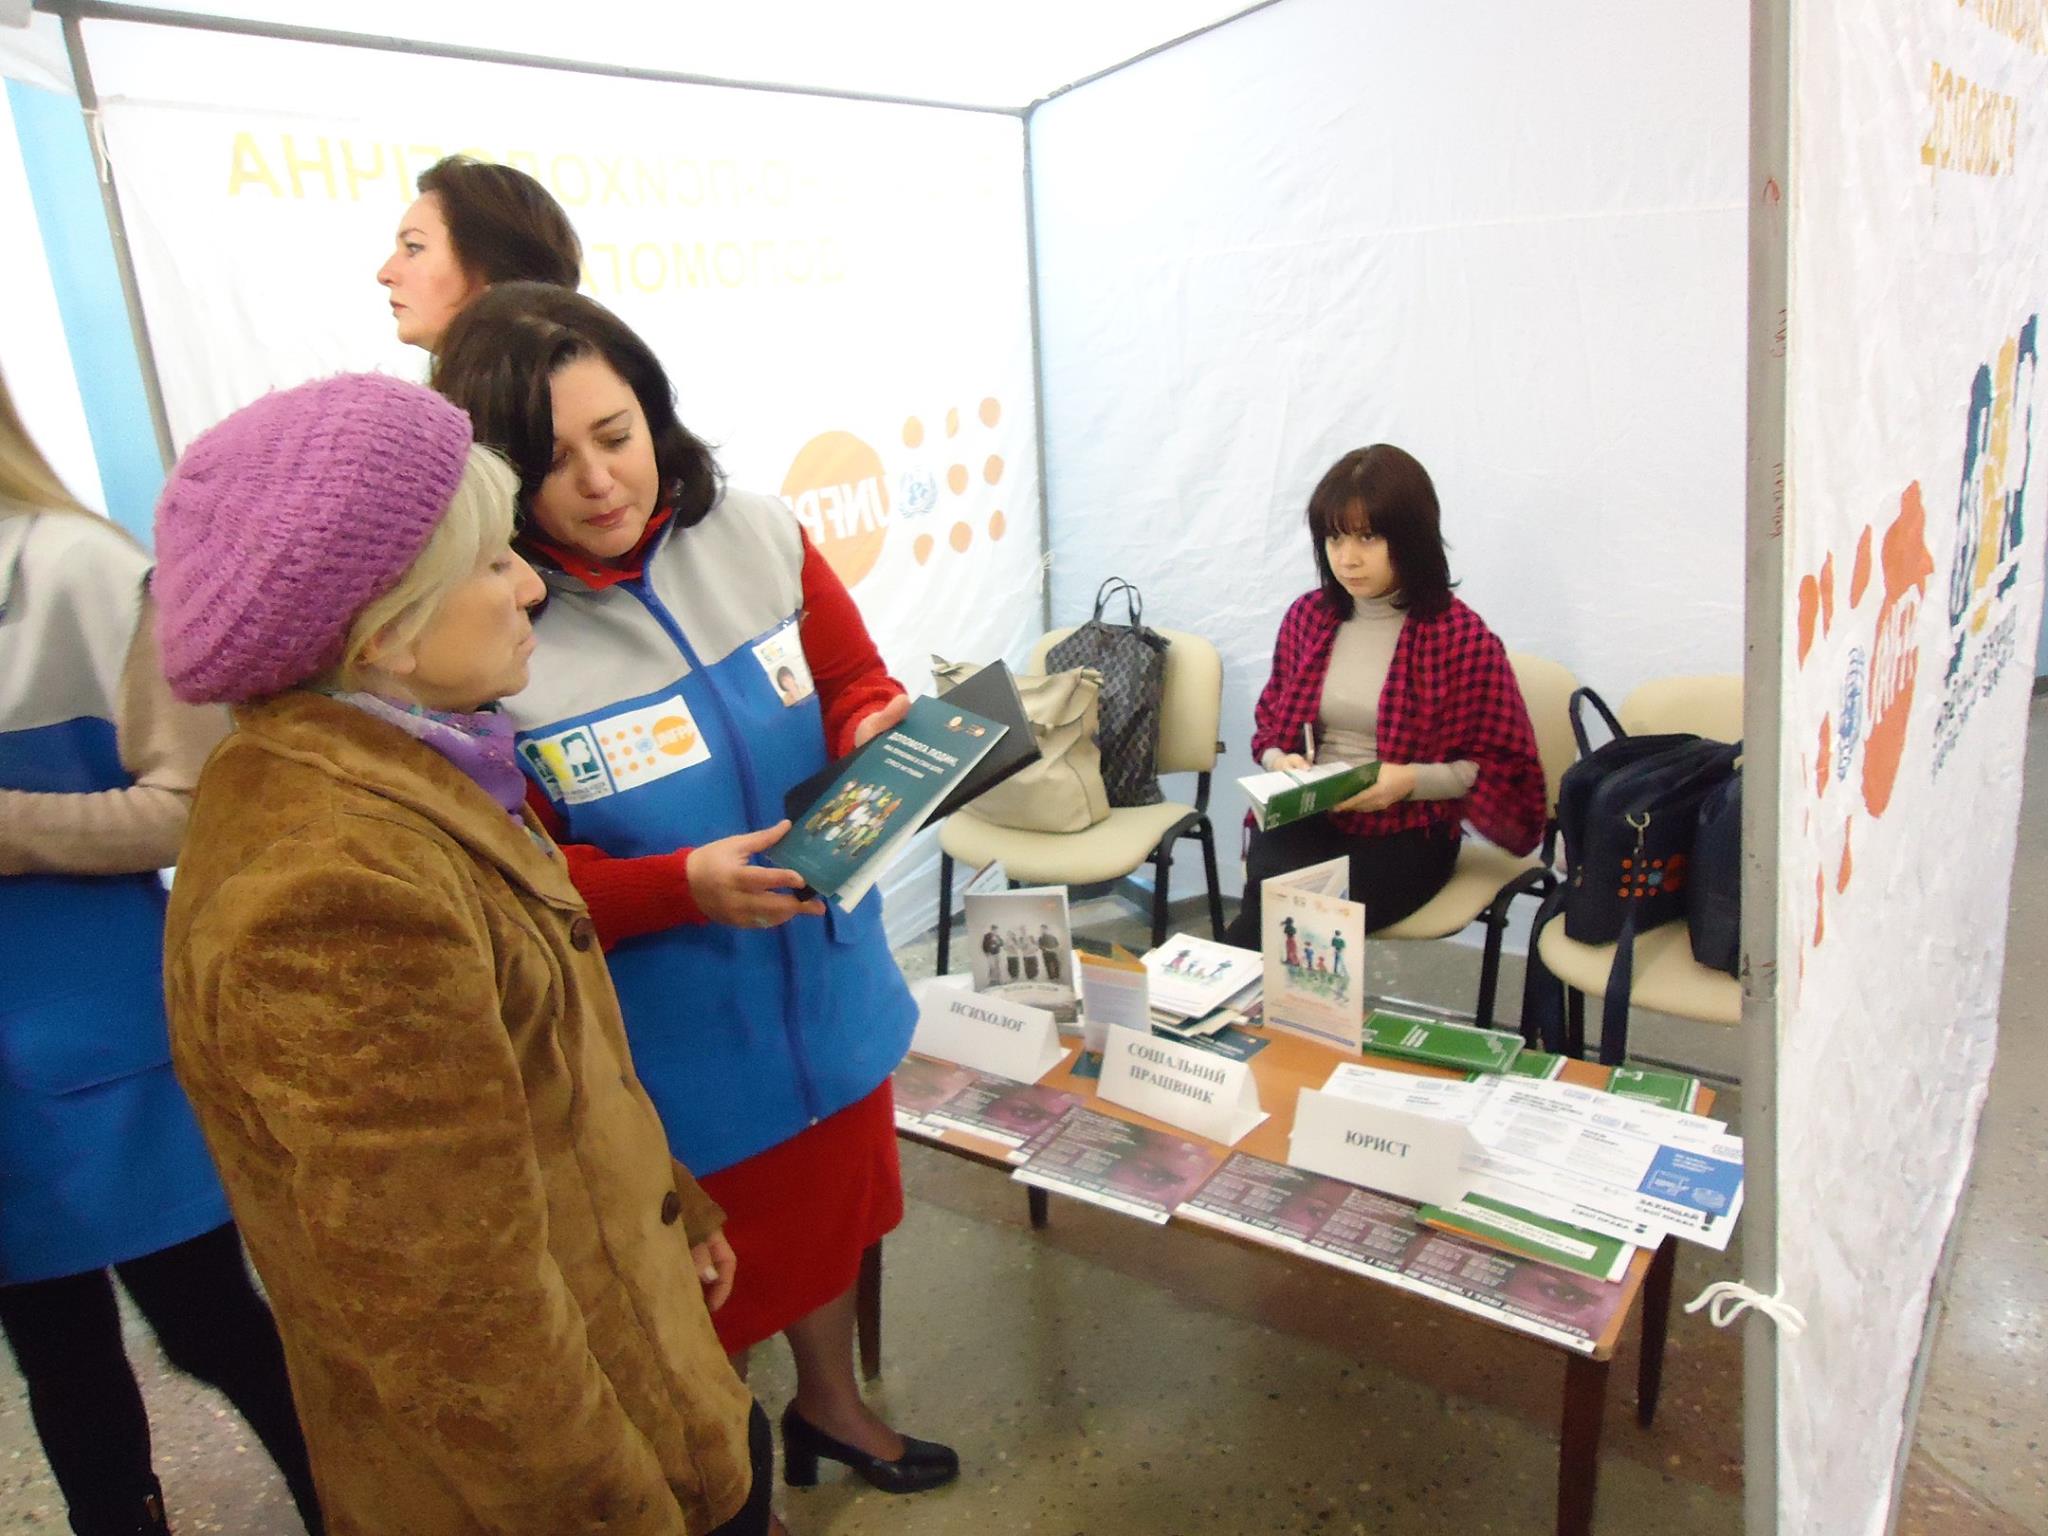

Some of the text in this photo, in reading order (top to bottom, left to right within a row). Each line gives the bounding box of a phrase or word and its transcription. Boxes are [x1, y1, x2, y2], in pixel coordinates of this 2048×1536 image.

[950, 1000, 1027, 1033] ПСИХОЛОГ
[1127, 1042, 1227, 1085] СОЦІАЛЬНИЙ
[1130, 1066, 1216, 1106] ПРАЦІВНИК
[1344, 1129, 1412, 1159] ЮРИСТ
